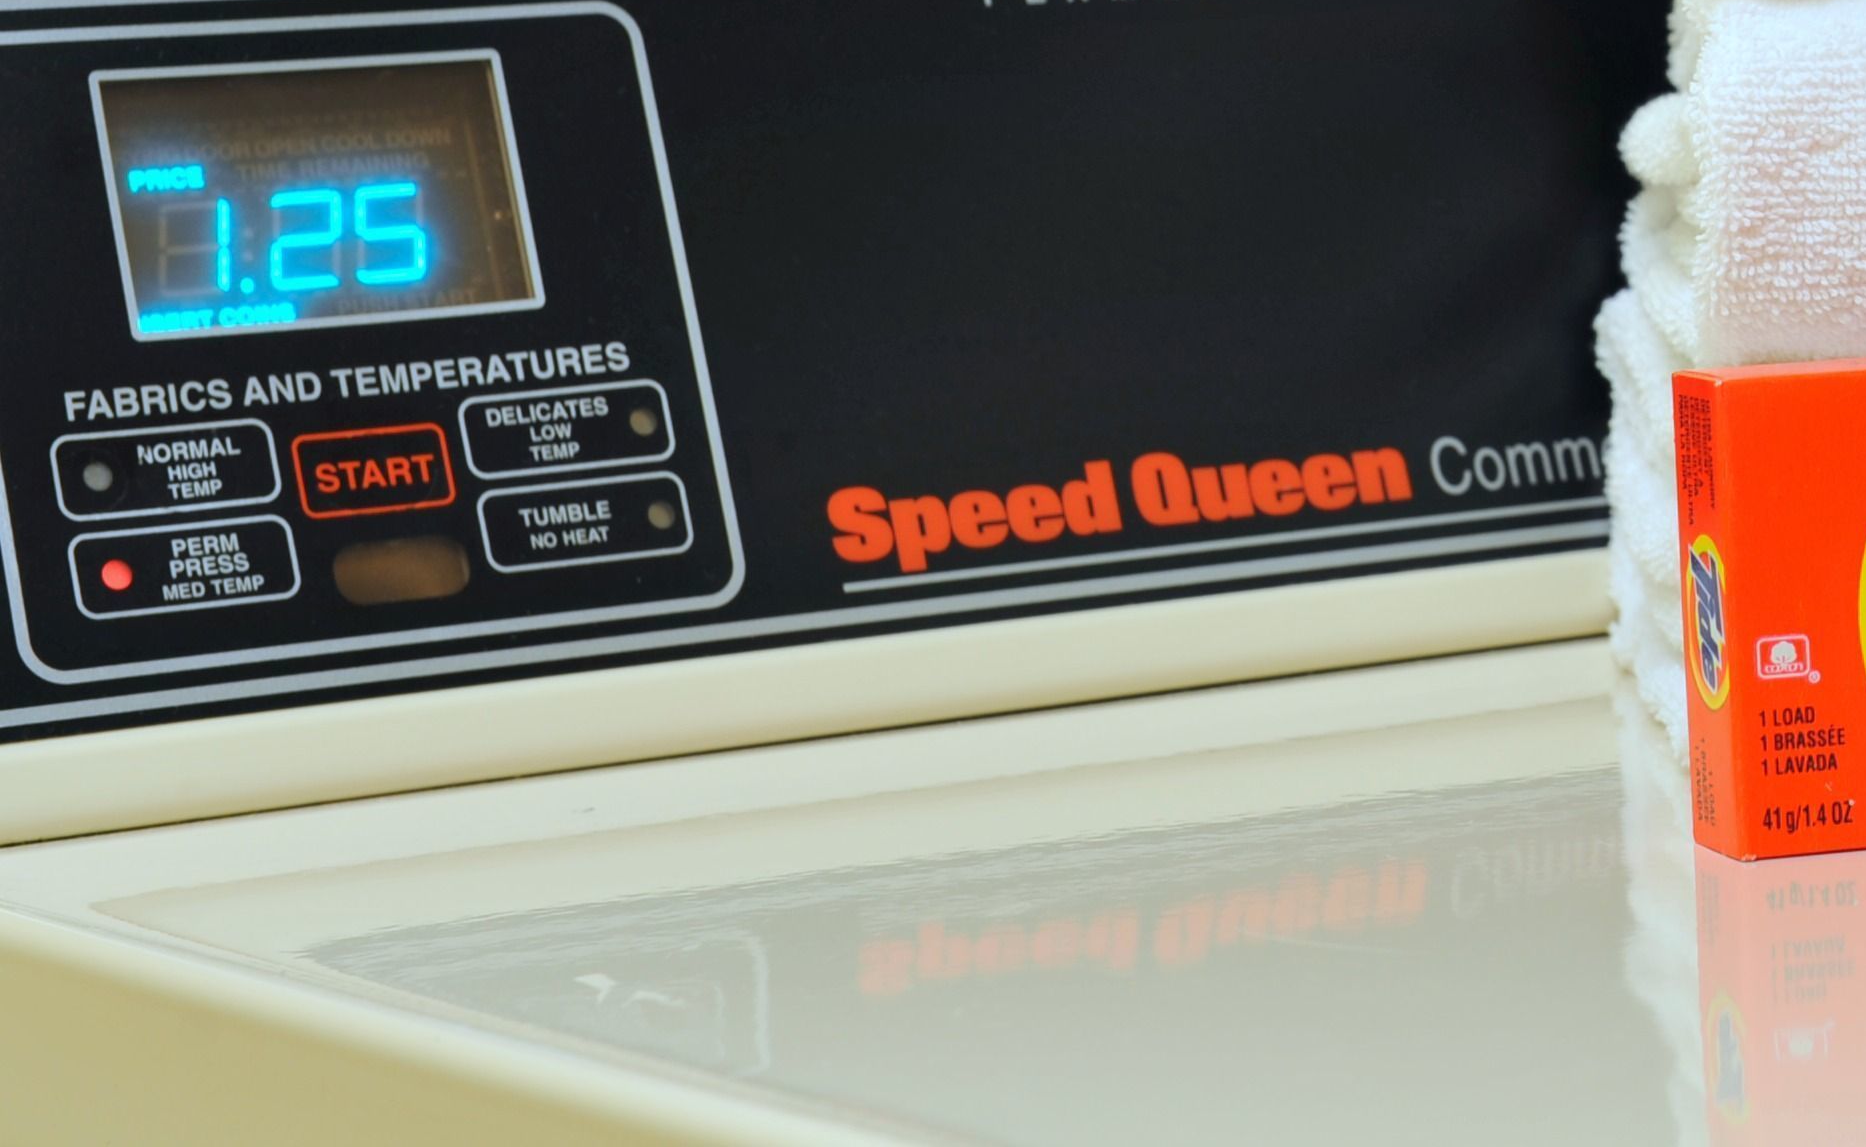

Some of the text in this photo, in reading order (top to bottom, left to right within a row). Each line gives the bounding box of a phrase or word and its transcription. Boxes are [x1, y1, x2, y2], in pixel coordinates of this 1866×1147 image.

[128, 164, 205, 194] PRICE
[217, 182, 427, 291] 1.25
[64, 342, 630, 422] FABRICS AND TEMPERATURES
[485, 396, 609, 428] DELICATES
[530, 423, 572, 442] LOW
[136, 437, 241, 466] NORMAL
[529, 441, 580, 463] TEMP
[167, 461, 217, 482] HIGH
[314, 454, 435, 494] START
[167, 479, 223, 500] TEMP
[519, 500, 612, 528] TUMBLE
[826, 460, 1123, 575] Speed
[1130, 447, 1413, 530] Queen
[1430, 435, 1610, 497] Comm
[171, 533, 239, 558] PERM
[530, 525, 610, 550] NO HEAT
[169, 553, 249, 579] PRESS
[162, 575, 265, 601] MED TEMP
[1688, 544, 1725, 695] Tide
[1760, 706, 1815, 727] 1 LOAD
[1761, 724, 1845, 751] 1 BRASSÉE
[1762, 753, 1838, 776] 1 LAVADA
[1832, 800, 1853, 825] OZ
